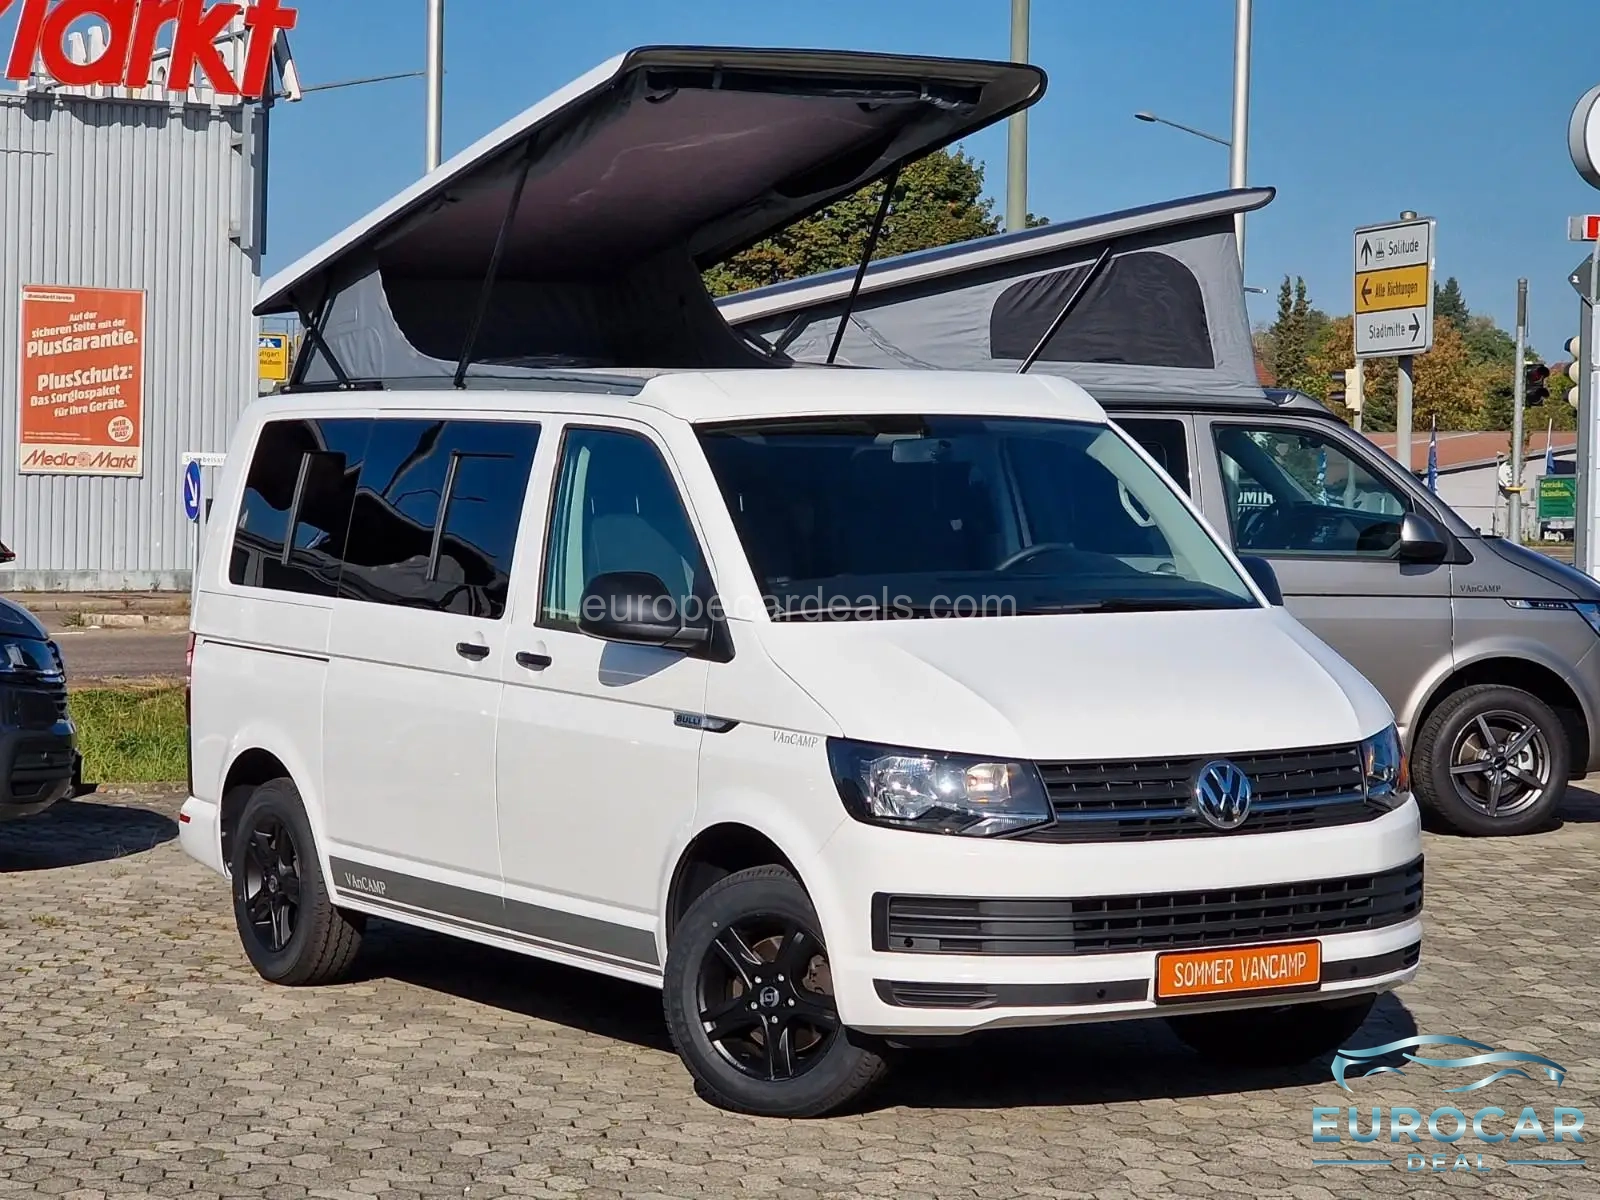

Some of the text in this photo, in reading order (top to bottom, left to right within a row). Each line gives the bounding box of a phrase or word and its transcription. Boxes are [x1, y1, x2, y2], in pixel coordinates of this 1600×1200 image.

[1388, 239, 1419, 256] Solitude
[1375, 281, 1418, 298] Alle Richtungen
[69, 311, 98, 322] Auf der
[31, 318, 126, 339] sicheren Seite mit der
[1369, 323, 1405, 339] Stadtmitte
[26, 329, 138, 359] PlusGarantie.
[38, 364, 133, 392] PlusSchutz:
[30, 384, 120, 407] Das Sorglospaket
[54, 399, 127, 418] für Ihre Geräte.
[23, 449, 137, 468] Media Markt
[1460, 584, 1501, 593] VAnCAMP
[773, 730, 818, 748] VAnCAMP
[344, 872, 386, 895] VAnCAMP
[1174, 952, 1307, 988] SOMMER VANCAMP
